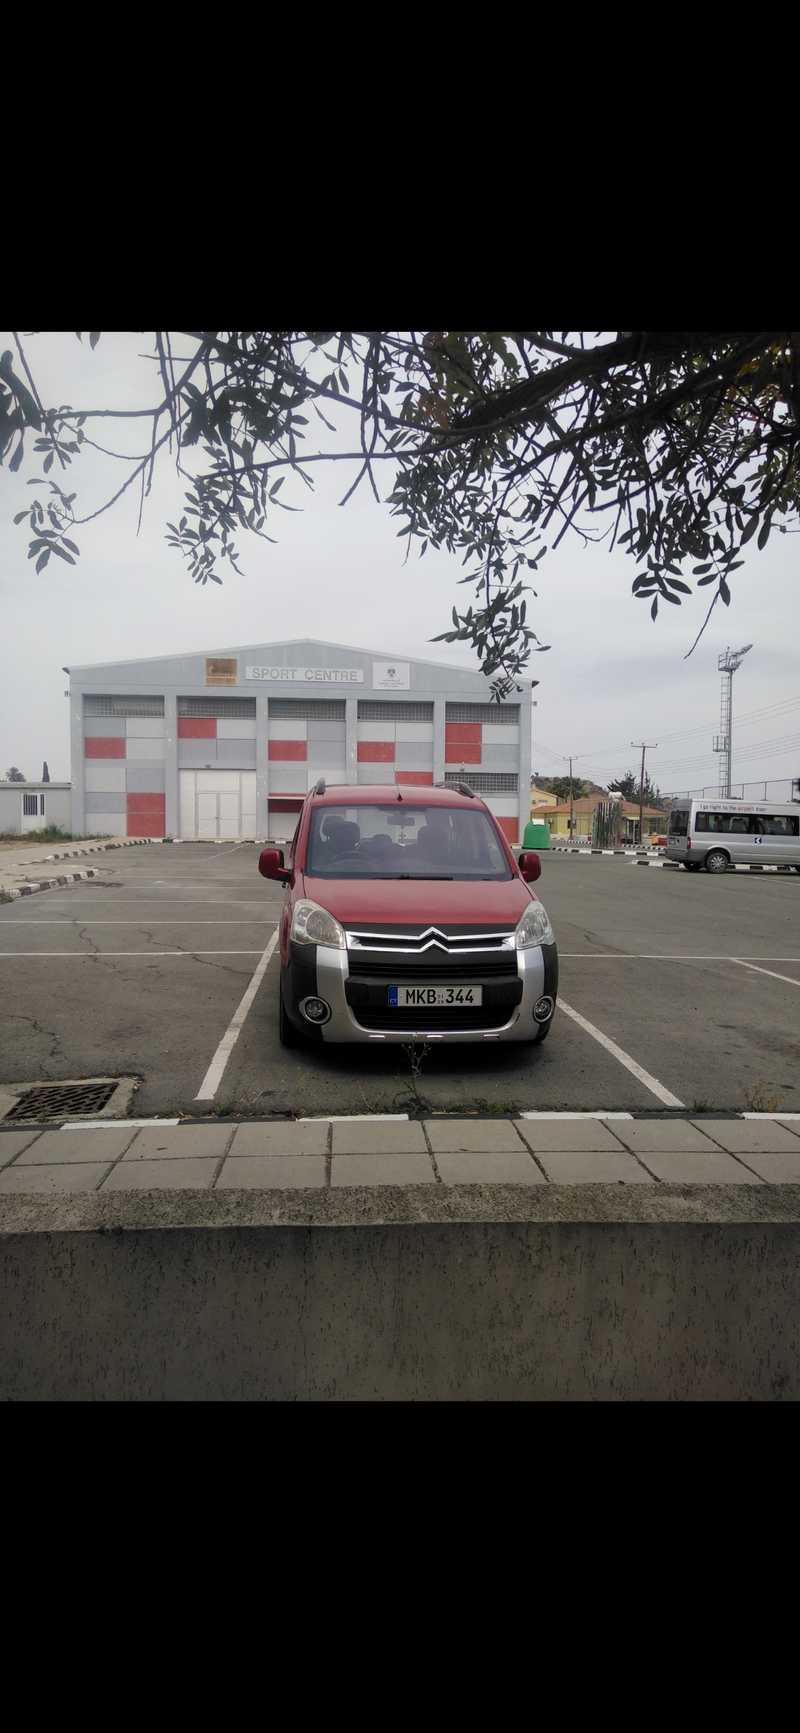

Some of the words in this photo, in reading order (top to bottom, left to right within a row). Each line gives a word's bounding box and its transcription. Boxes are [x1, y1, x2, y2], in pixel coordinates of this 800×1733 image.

[252, 667, 297, 680] SPORT
[304, 668, 358, 681] CENTRE
[406, 989, 437, 1004] MKB
[445, 989, 474, 1004] 344
